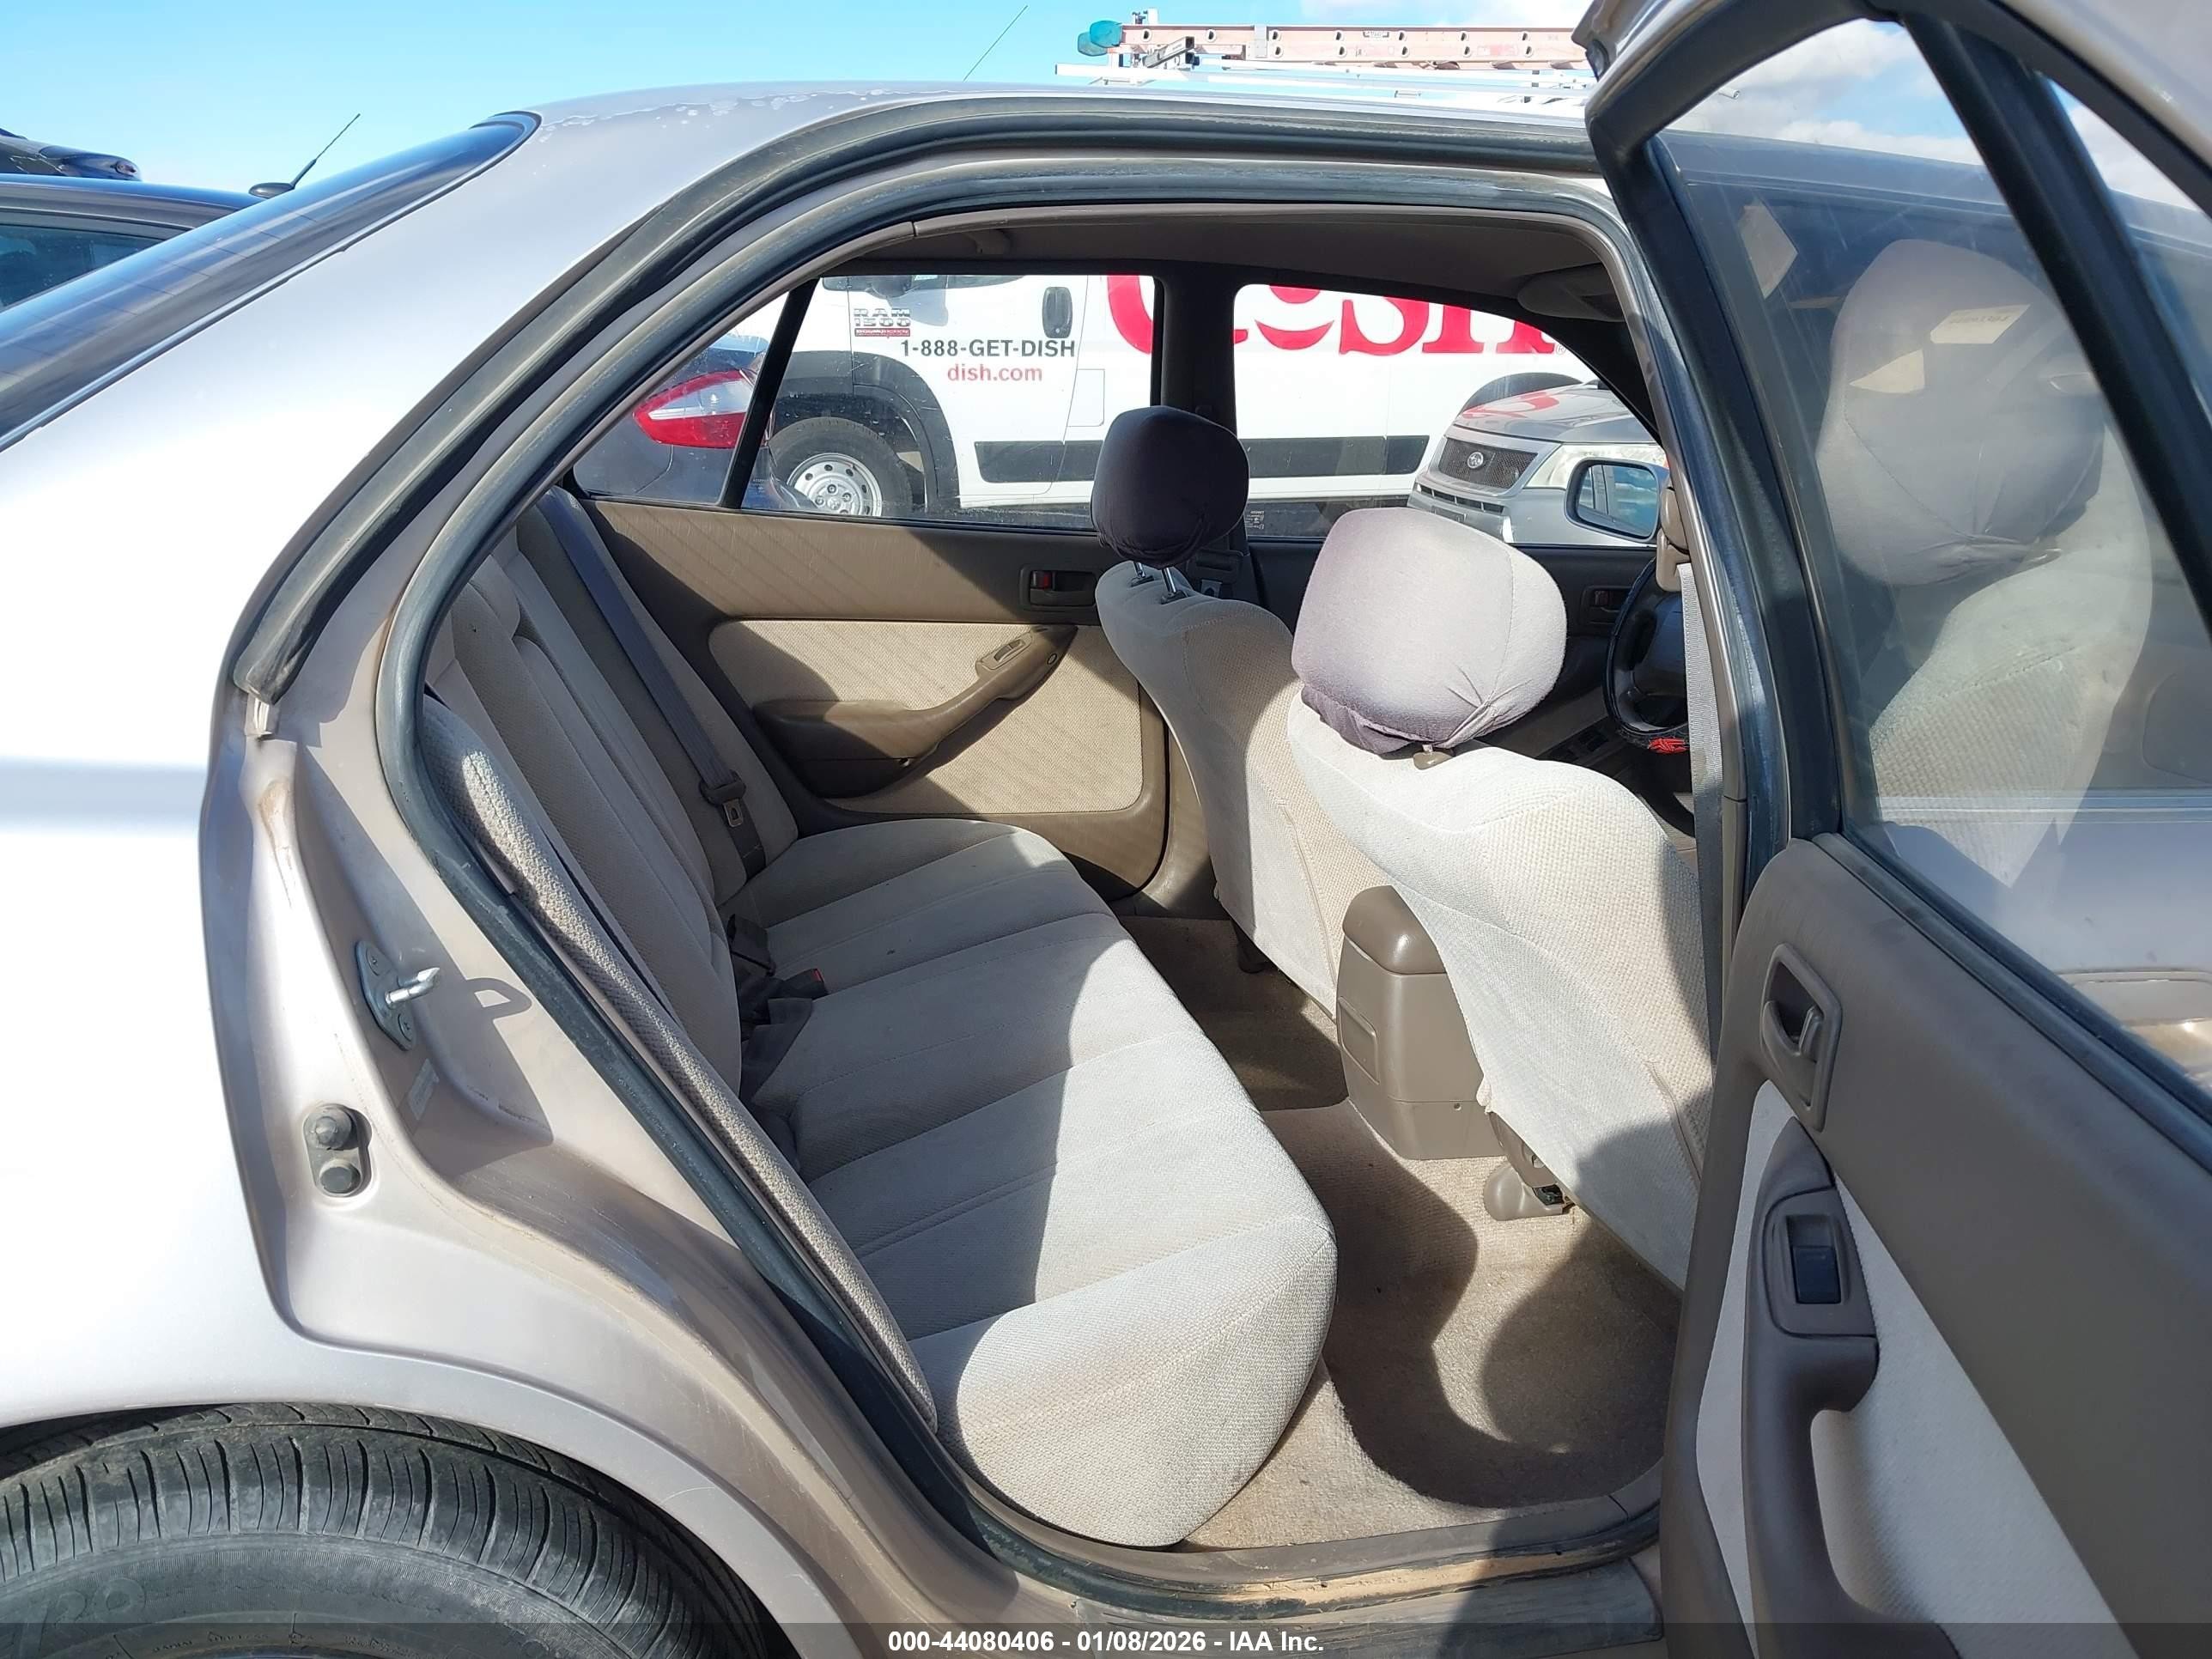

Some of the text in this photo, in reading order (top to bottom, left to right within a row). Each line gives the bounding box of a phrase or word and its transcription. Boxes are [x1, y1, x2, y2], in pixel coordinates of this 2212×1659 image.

[854, 308, 910, 317] RAM
[854, 318, 911, 327] 1500
[901, 340, 1075, 357] 1-888-GET-DISH
[947, 364, 1042, 381] dish.com
